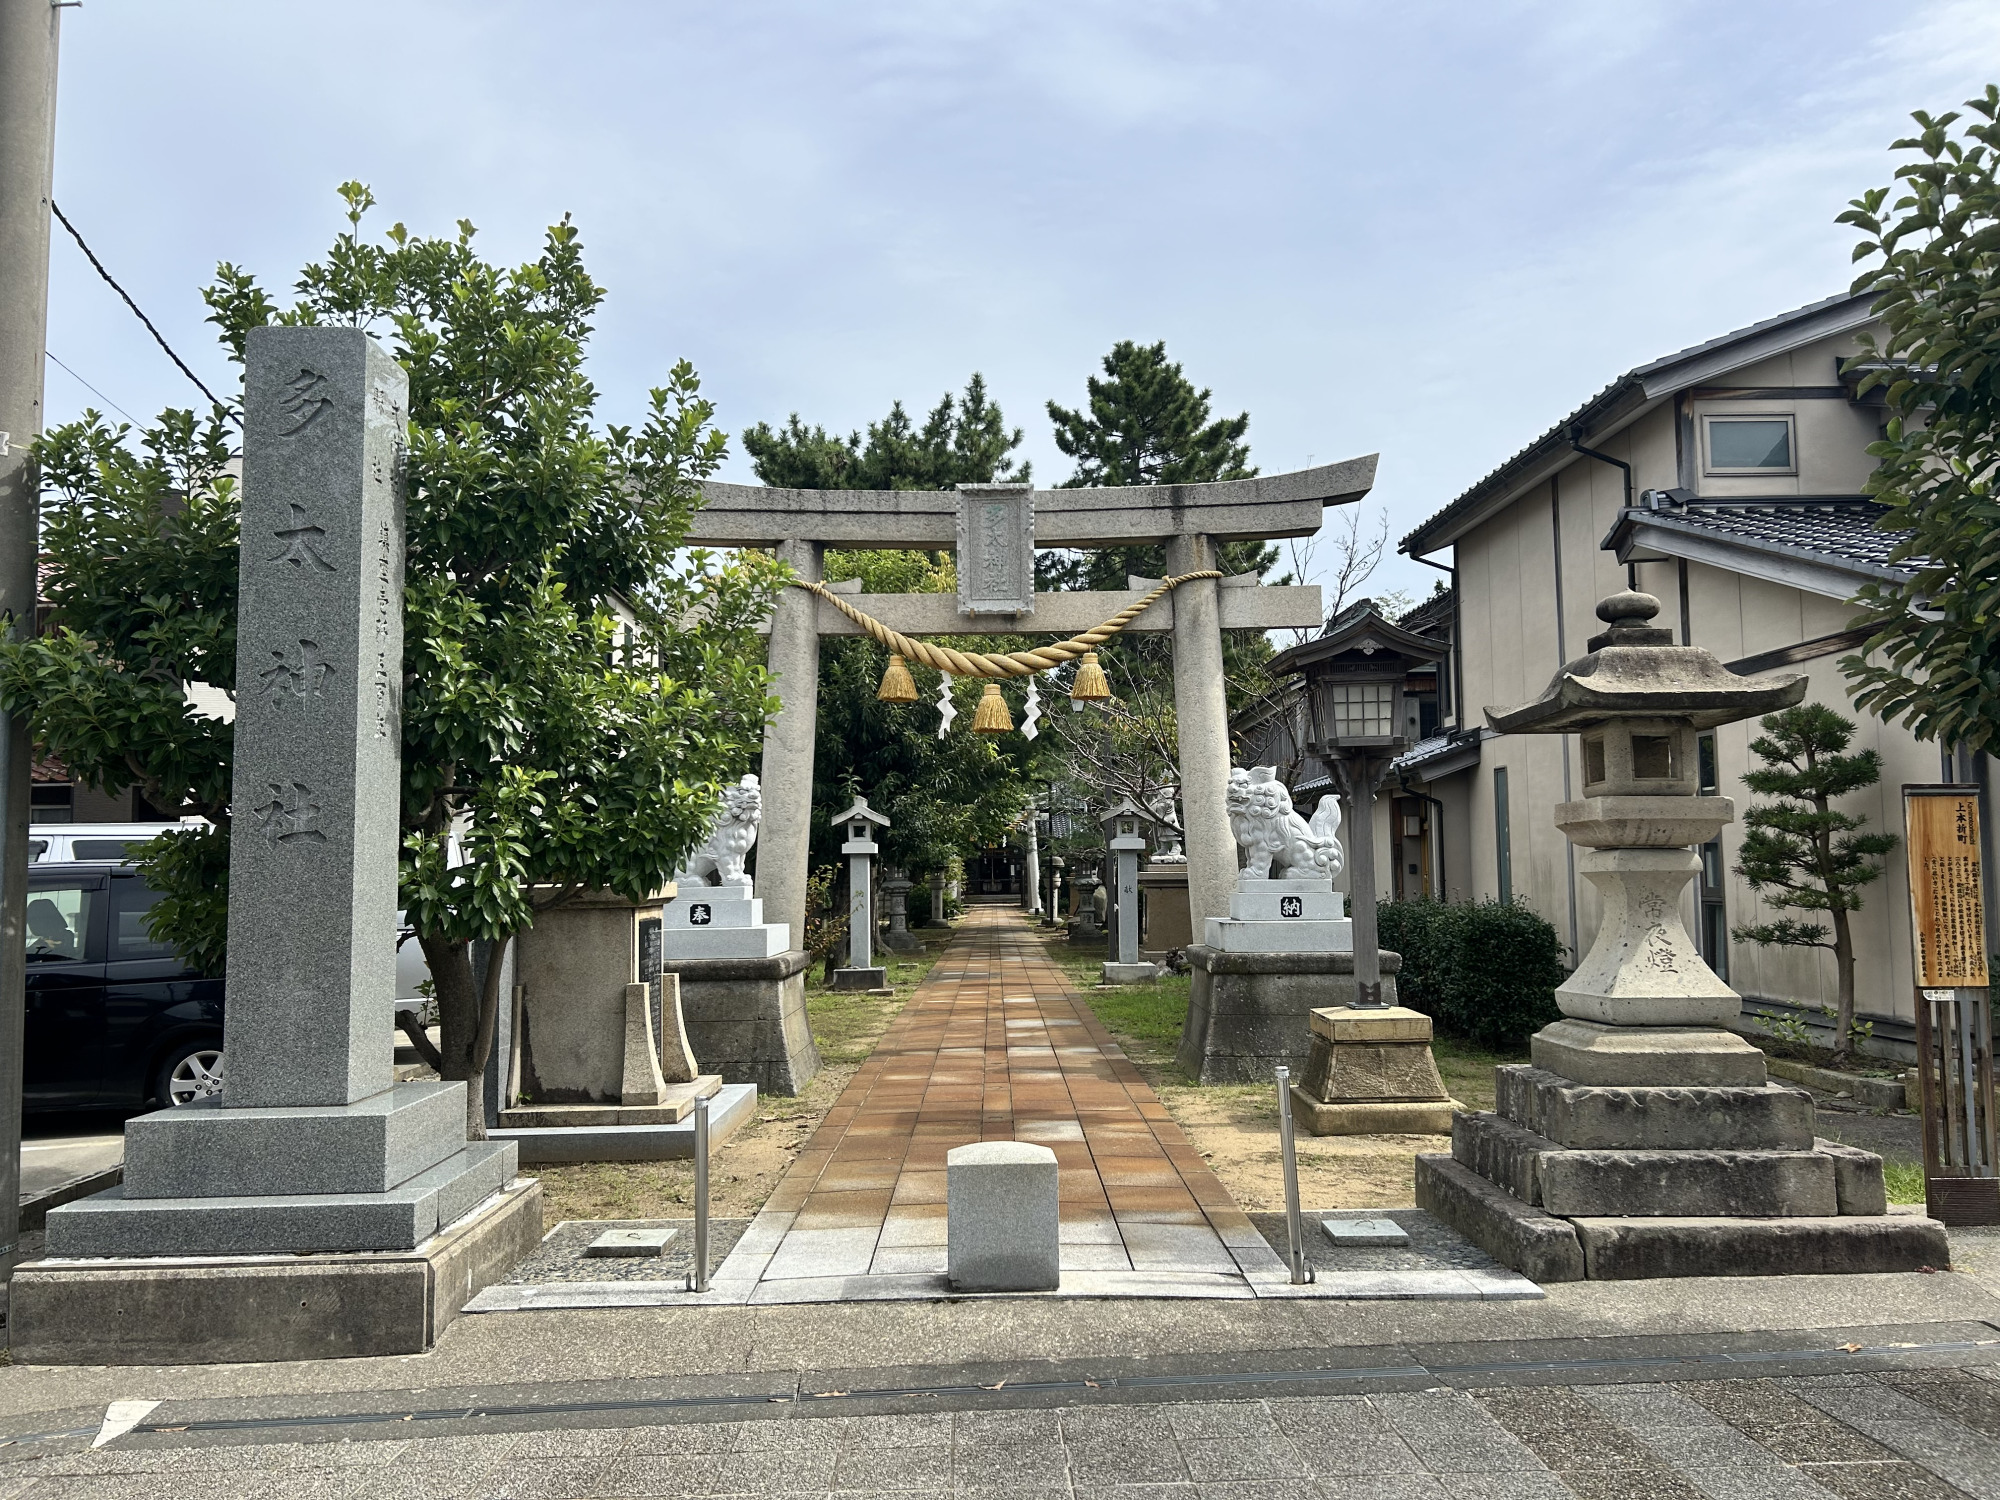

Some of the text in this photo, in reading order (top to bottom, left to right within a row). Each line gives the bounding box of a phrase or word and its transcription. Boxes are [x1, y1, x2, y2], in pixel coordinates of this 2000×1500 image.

[981, 503, 1009, 592] 多太神社
[253, 367, 338, 850] 多太神社
[1955, 801, 1968, 845] 上本折町
[691, 905, 710, 924] 奉
[1281, 898, 1301, 916] 納
[1638, 891, 1679, 974] 常夜燈
